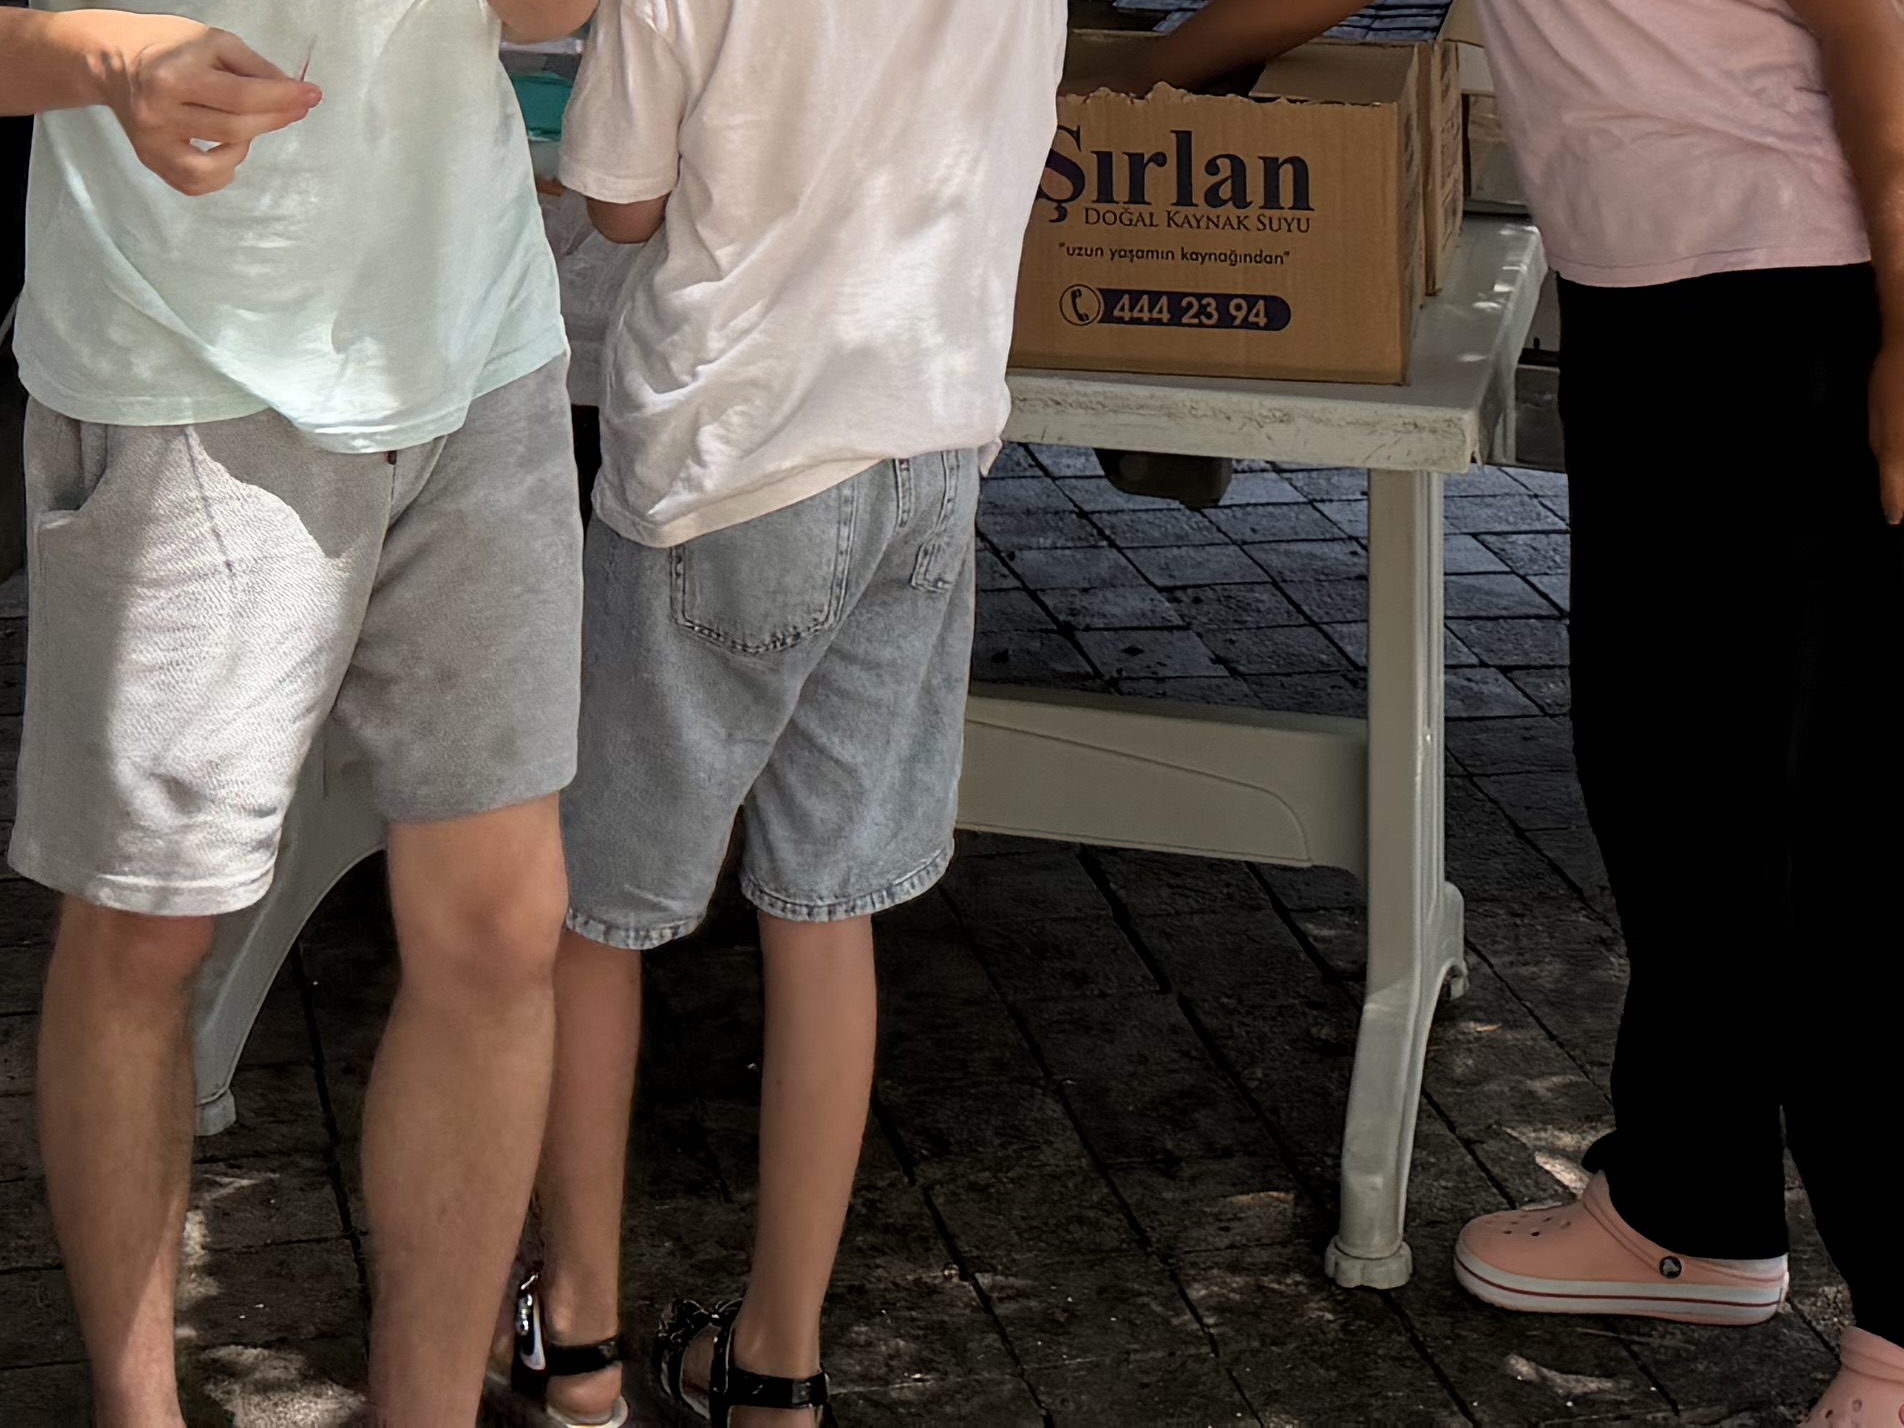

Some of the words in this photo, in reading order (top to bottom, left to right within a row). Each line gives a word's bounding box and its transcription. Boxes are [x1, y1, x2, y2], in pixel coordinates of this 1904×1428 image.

[1036, 122, 1316, 224] Şırlan
[1083, 206, 1159, 228] DOĞAL
[1165, 209, 1251, 232] KAYNAK
[1256, 213, 1312, 234] SUYU
[1109, 245, 1175, 262] yaşamın
[1112, 294, 1171, 324] 444
[1180, 296, 1219, 326] 23
[1228, 298, 1268, 328] 94
